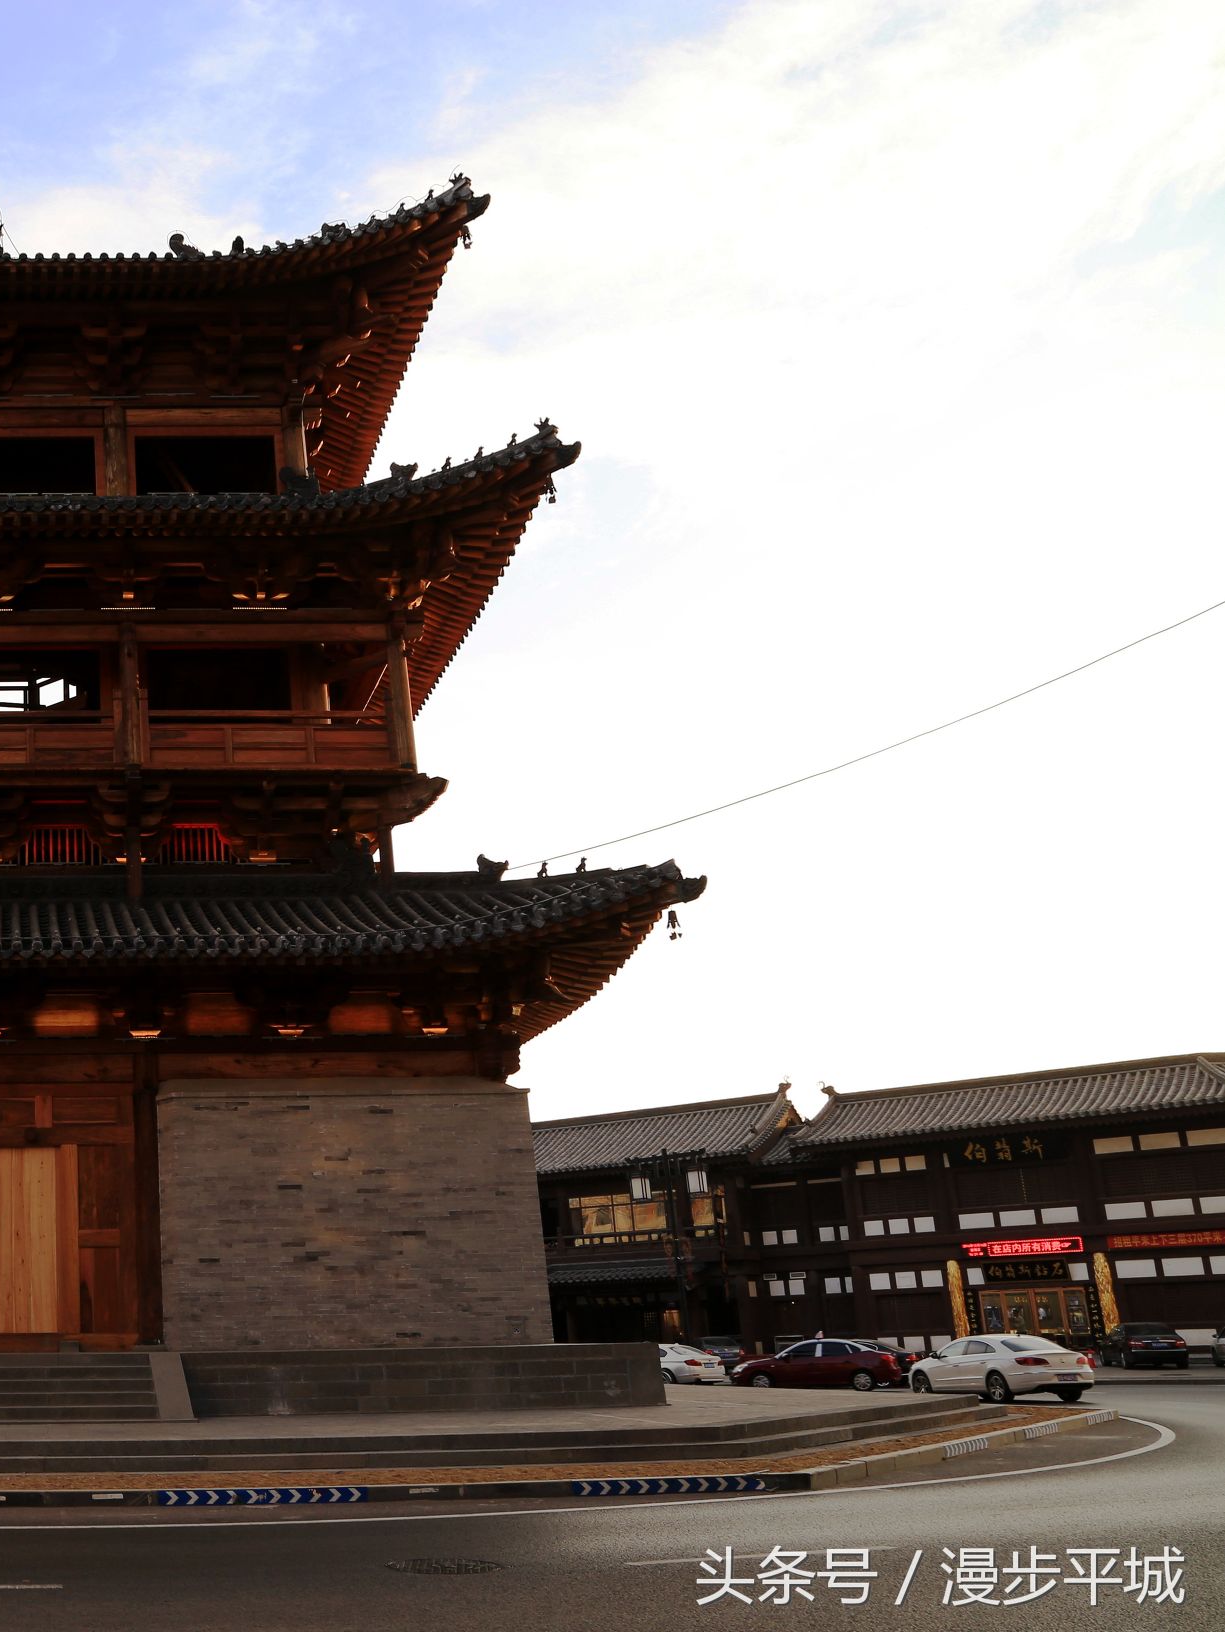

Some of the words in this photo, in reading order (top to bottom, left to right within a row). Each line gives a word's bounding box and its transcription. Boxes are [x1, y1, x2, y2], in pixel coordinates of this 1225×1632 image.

[992, 1241, 1062, 1254] 在店内所有消费
